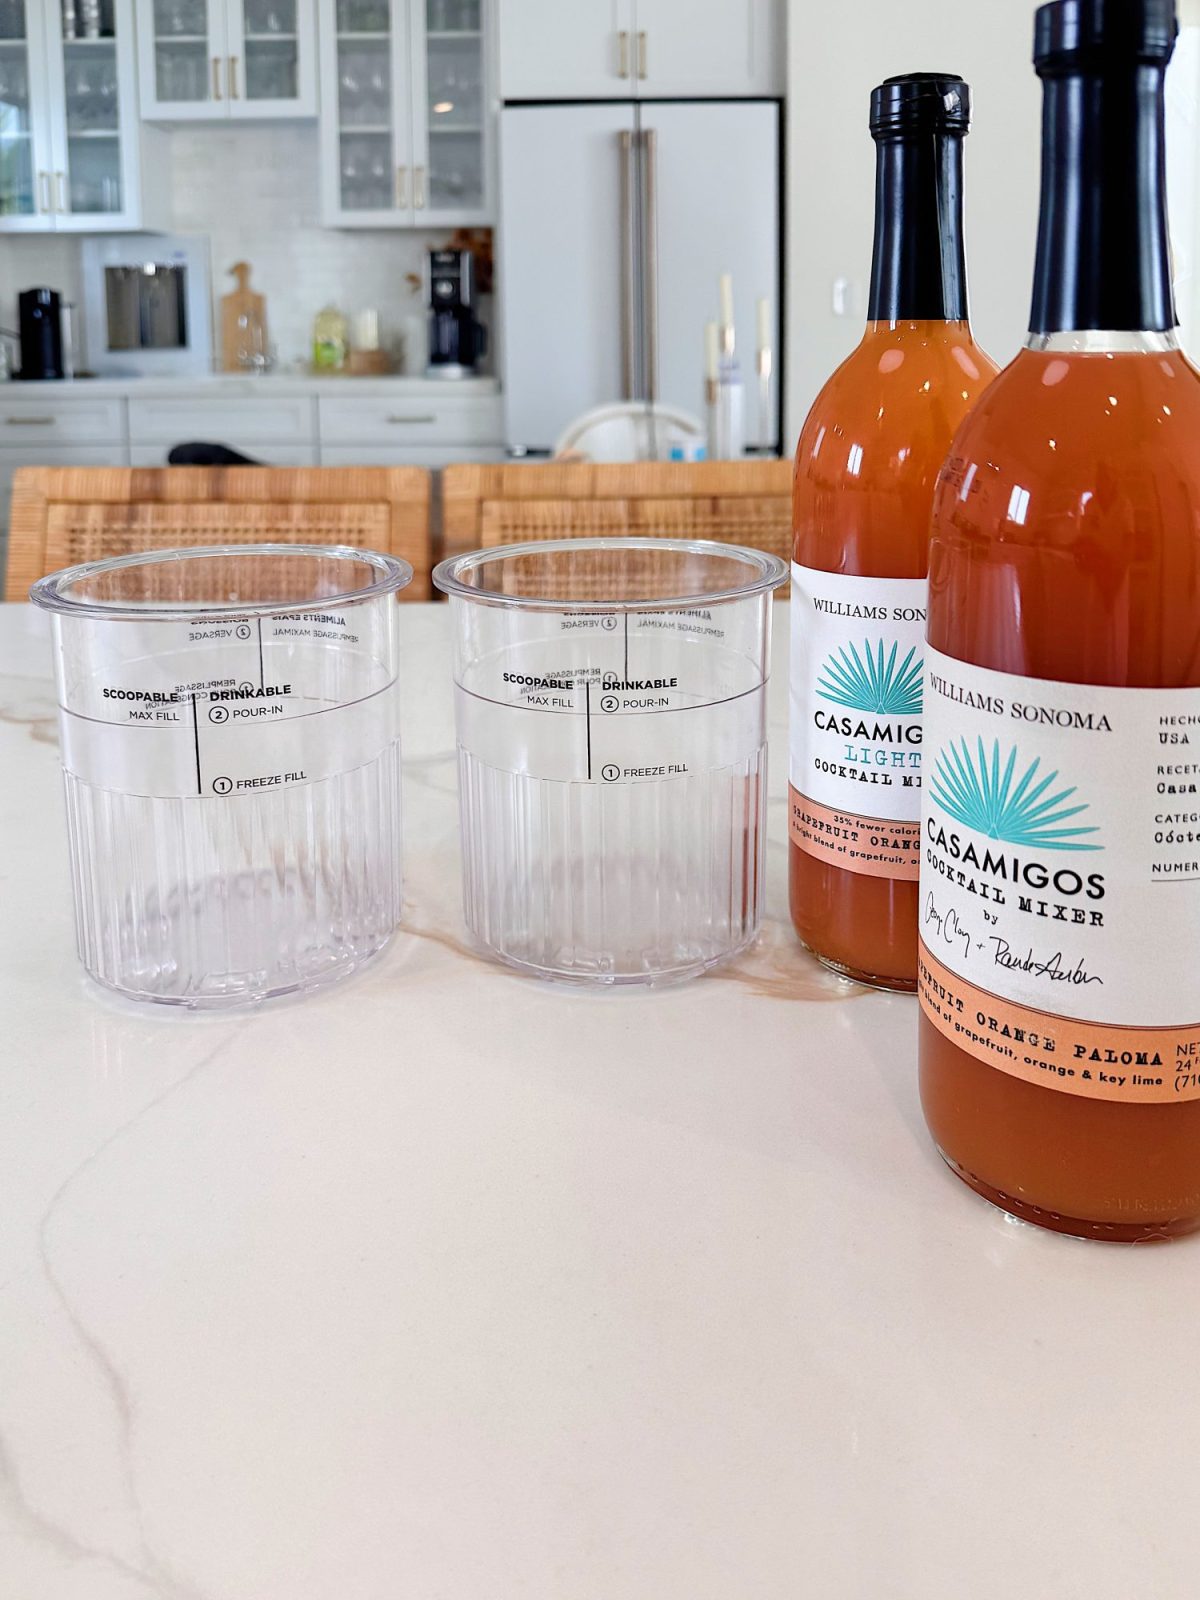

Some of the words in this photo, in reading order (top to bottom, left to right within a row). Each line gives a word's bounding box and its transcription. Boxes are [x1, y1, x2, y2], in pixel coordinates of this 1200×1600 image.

[813, 598, 887, 620] WILLIAMS
[503, 672, 574, 690] SCOOPABLE
[602, 677, 678, 691] DRINKABLE
[103, 688, 179, 703] SCOOPABLE
[209, 684, 292, 702] DRINKABLE
[527, 695, 549, 706] MAX
[552, 697, 574, 708] FILL
[930, 672, 1004, 715] WILLIAMS
[1010, 702, 1112, 732] SONOMA
[623, 697, 669, 708] POUR-IN
[129, 710, 154, 721] MAX
[156, 711, 180, 721] FILL
[233, 705, 283, 719] POUR-IN
[814, 710, 923, 744] CASAMIG
[1159, 732, 1190, 744] USA
[844, 744, 922, 768] LIGHT
[623, 766, 666, 778] FREEZE
[668, 763, 688, 774] FILL
[814, 758, 892, 786] COCKTAIL
[1157, 764, 1200, 775] RECET
[236, 775, 282, 790] FREEZE
[285, 770, 307, 782] FILL
[1157, 782, 1197, 794] Casa
[793, 804, 859, 842] GRAPEFRUIT
[870, 836, 920, 850] ORANG
[833, 815, 853, 826] 35%
[855, 821, 886, 833] fewer
[1154, 812, 1200, 824] CATEG
[813, 834, 835, 850] blend
[837, 845, 847, 853] of
[849, 848, 906, 865] grapefruit,
[927, 816, 1106, 900] CASAMIGOS
[1152, 861, 1199, 873] NUMER
[927, 848, 1006, 905] COCKTAIL
[1018, 896, 1104, 927] MIXER
[983, 909, 999, 925] by
[976, 1011, 1056, 1052] ORANGE
[1073, 1044, 1163, 1066] PALOMA
[943, 1012, 952, 1023] of
[954, 1022, 1018, 1060] grapefruit,
[1024, 1057, 1075, 1076] orange
[1082, 1070, 1092, 1080] &
[1099, 1072, 1126, 1086] key
[1132, 1074, 1163, 1085] lime
[1175, 1059, 1191, 1072] 24
